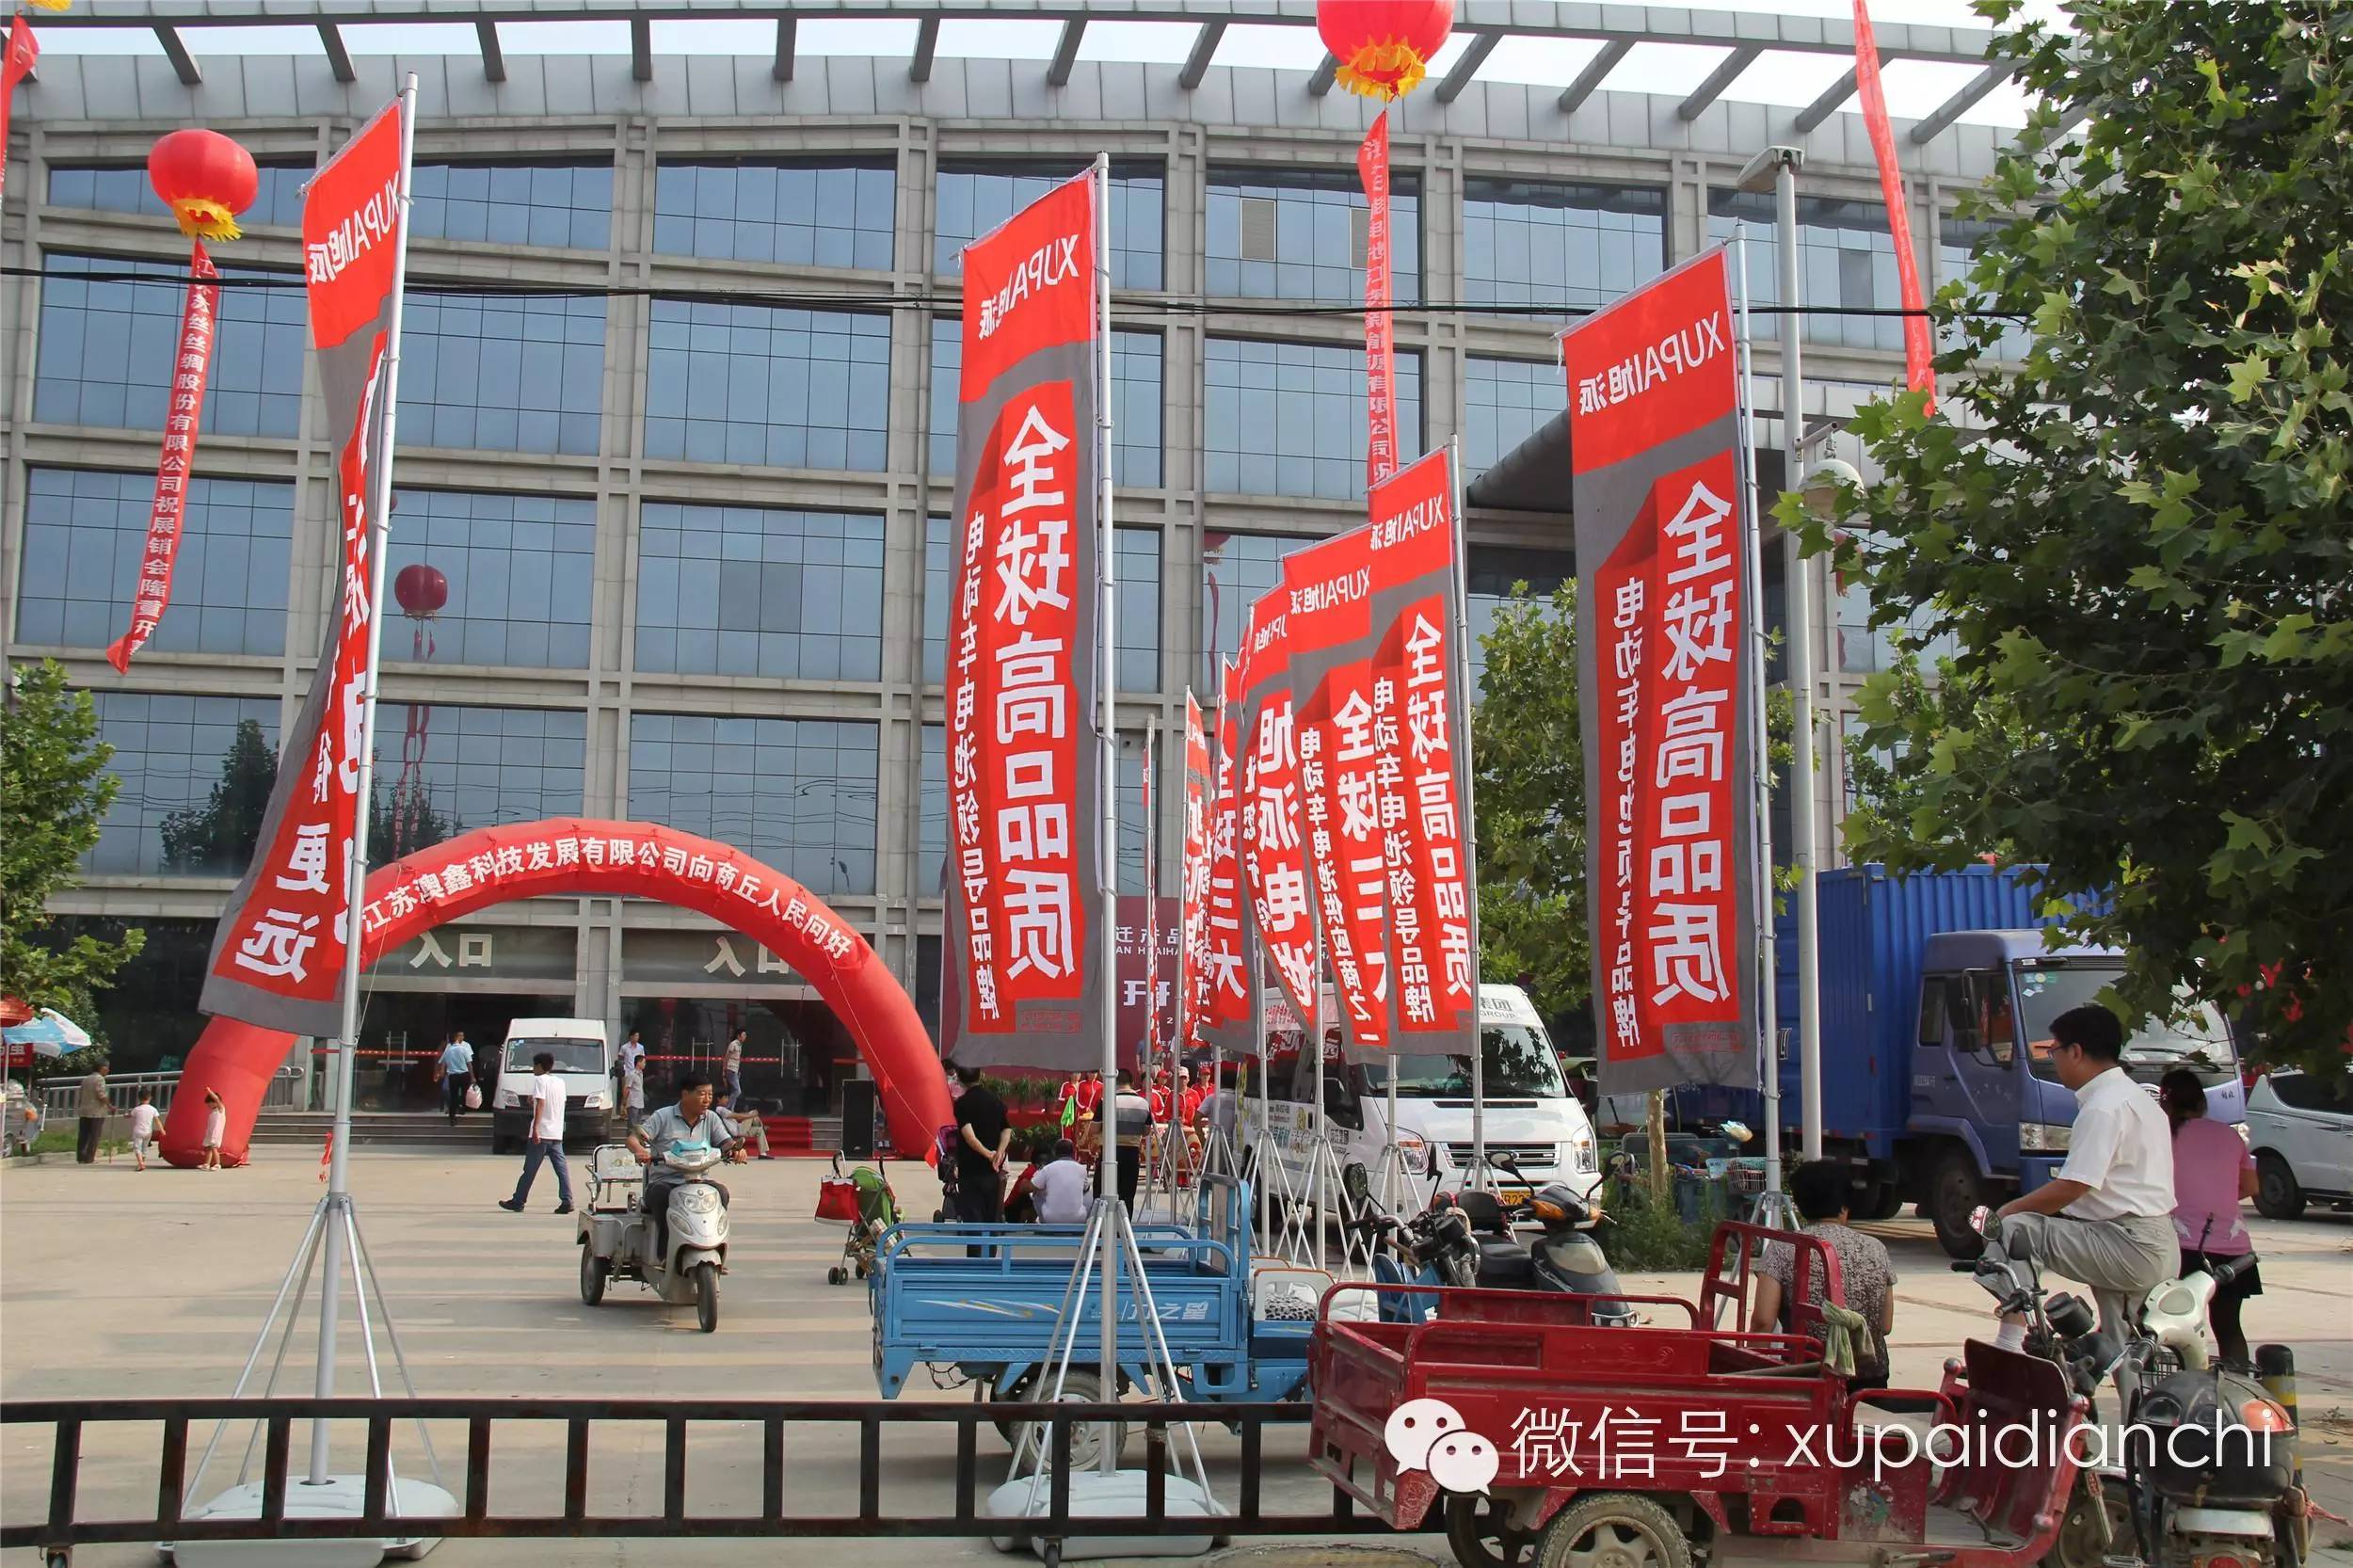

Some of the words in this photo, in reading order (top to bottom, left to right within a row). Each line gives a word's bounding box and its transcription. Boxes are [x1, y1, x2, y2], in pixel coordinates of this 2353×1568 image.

[362, 837, 852, 960] 江苏澳鑫科技发展有限公司向商丘人民问好
[409, 931, 493, 969] 入口
